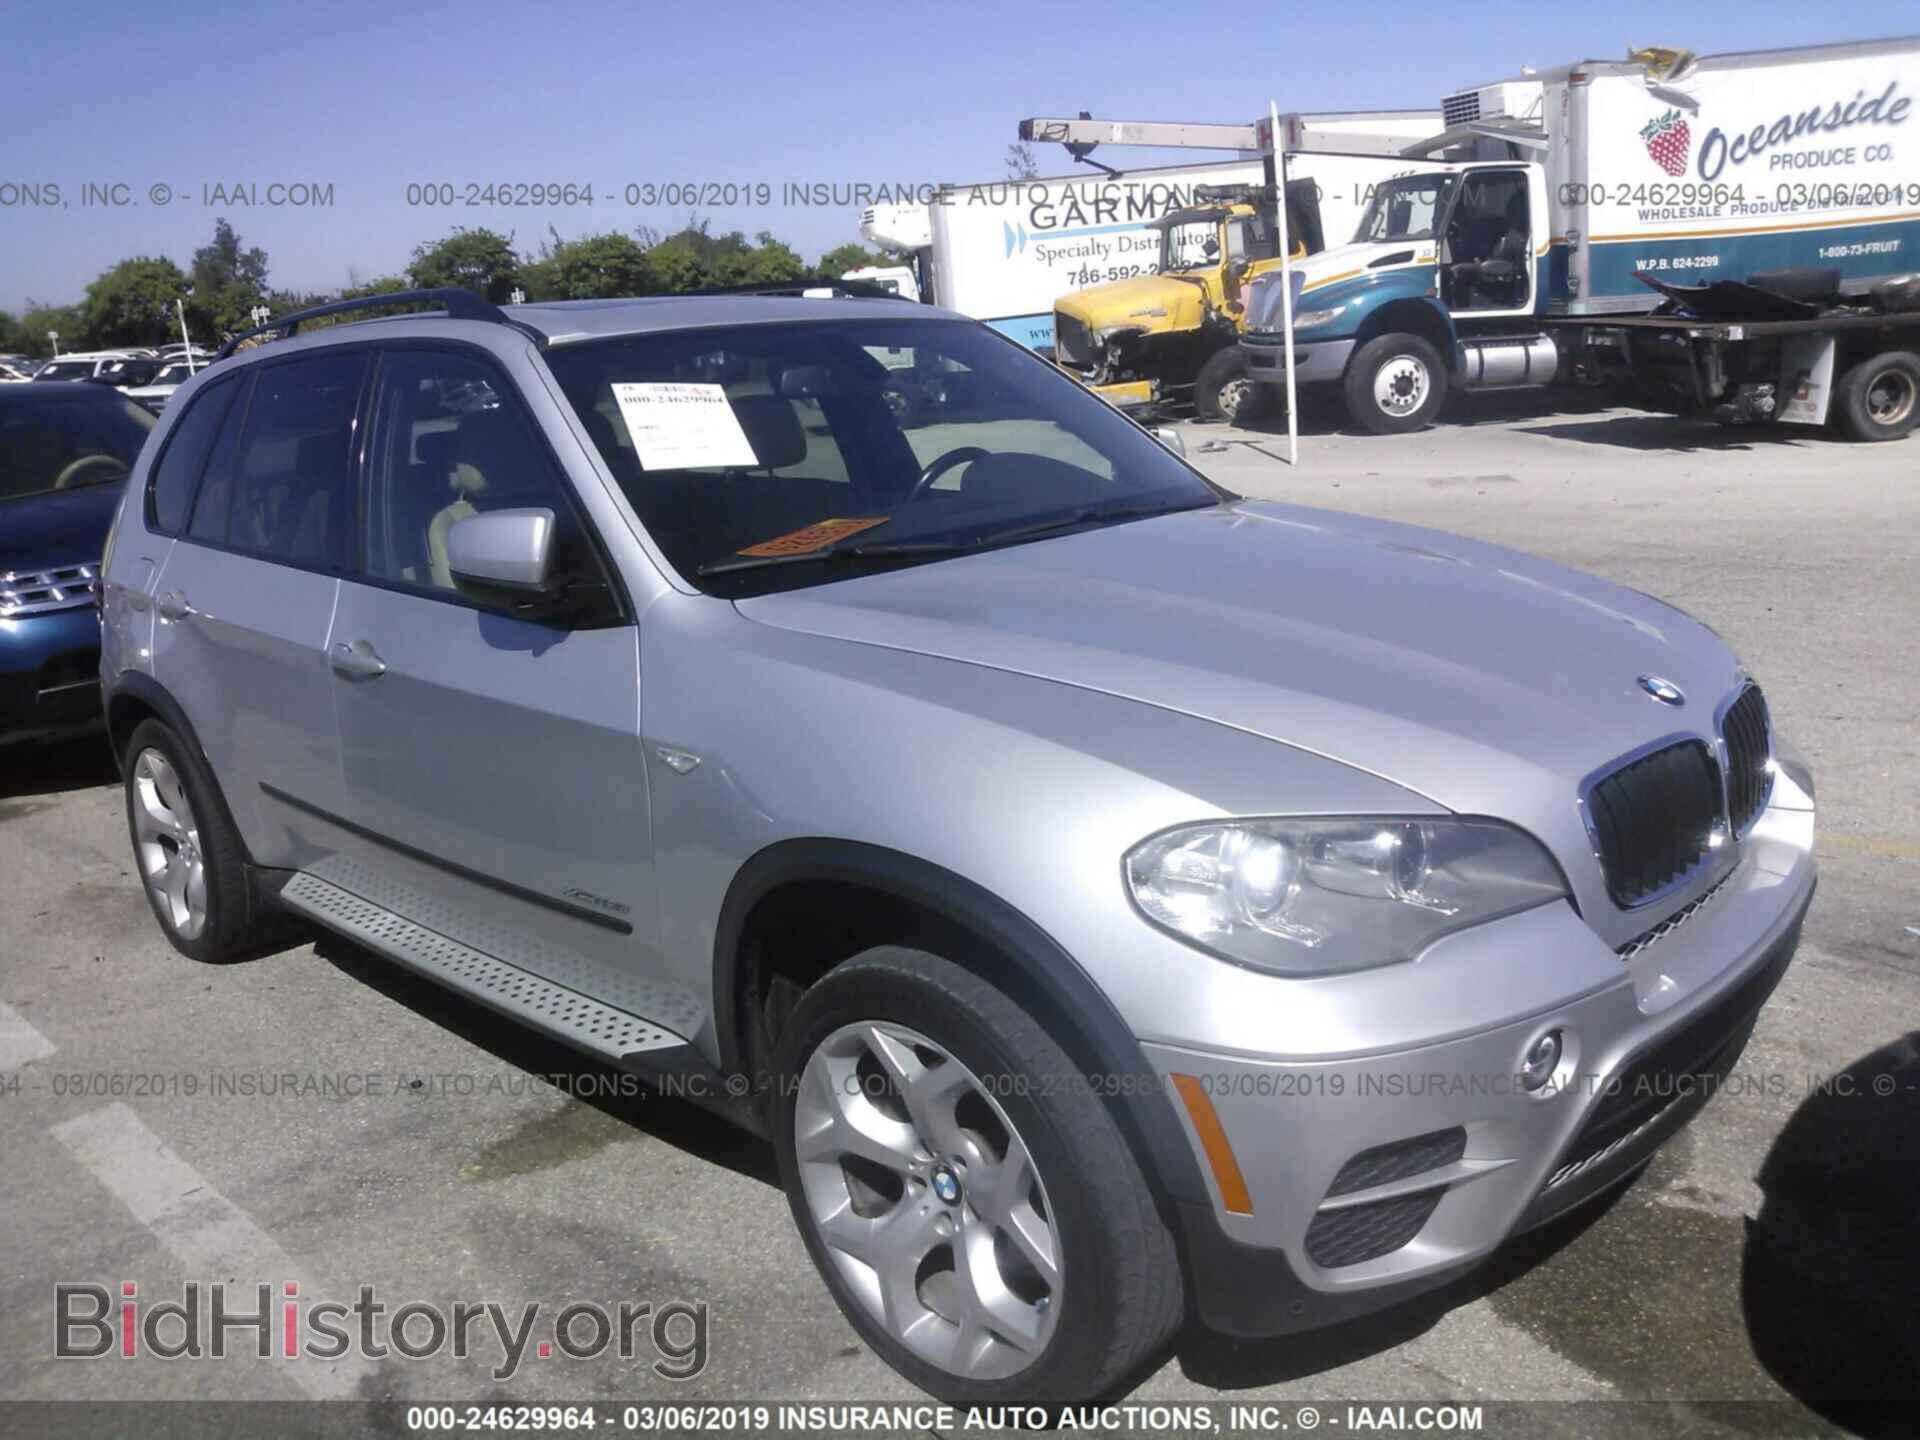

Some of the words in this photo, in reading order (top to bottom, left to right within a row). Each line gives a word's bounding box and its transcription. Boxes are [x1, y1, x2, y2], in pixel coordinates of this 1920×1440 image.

[1697, 80, 1912, 182] Oceanside
[1769, 146, 1856, 171] PRODUCE
[1863, 143, 1895, 162] CO.
[1638, 204, 1722, 221] WHOLESALE
[1730, 200, 1799, 216] PRODUCE
[1035, 237, 1112, 267] Specialty
[1117, 230, 1219, 253] Distrutors
[1636, 258, 1671, 271] W.P.B.
[1672, 255, 1720, 269] 624-2299
[1818, 239, 1901, 259] 1-800-73-FRUIT
